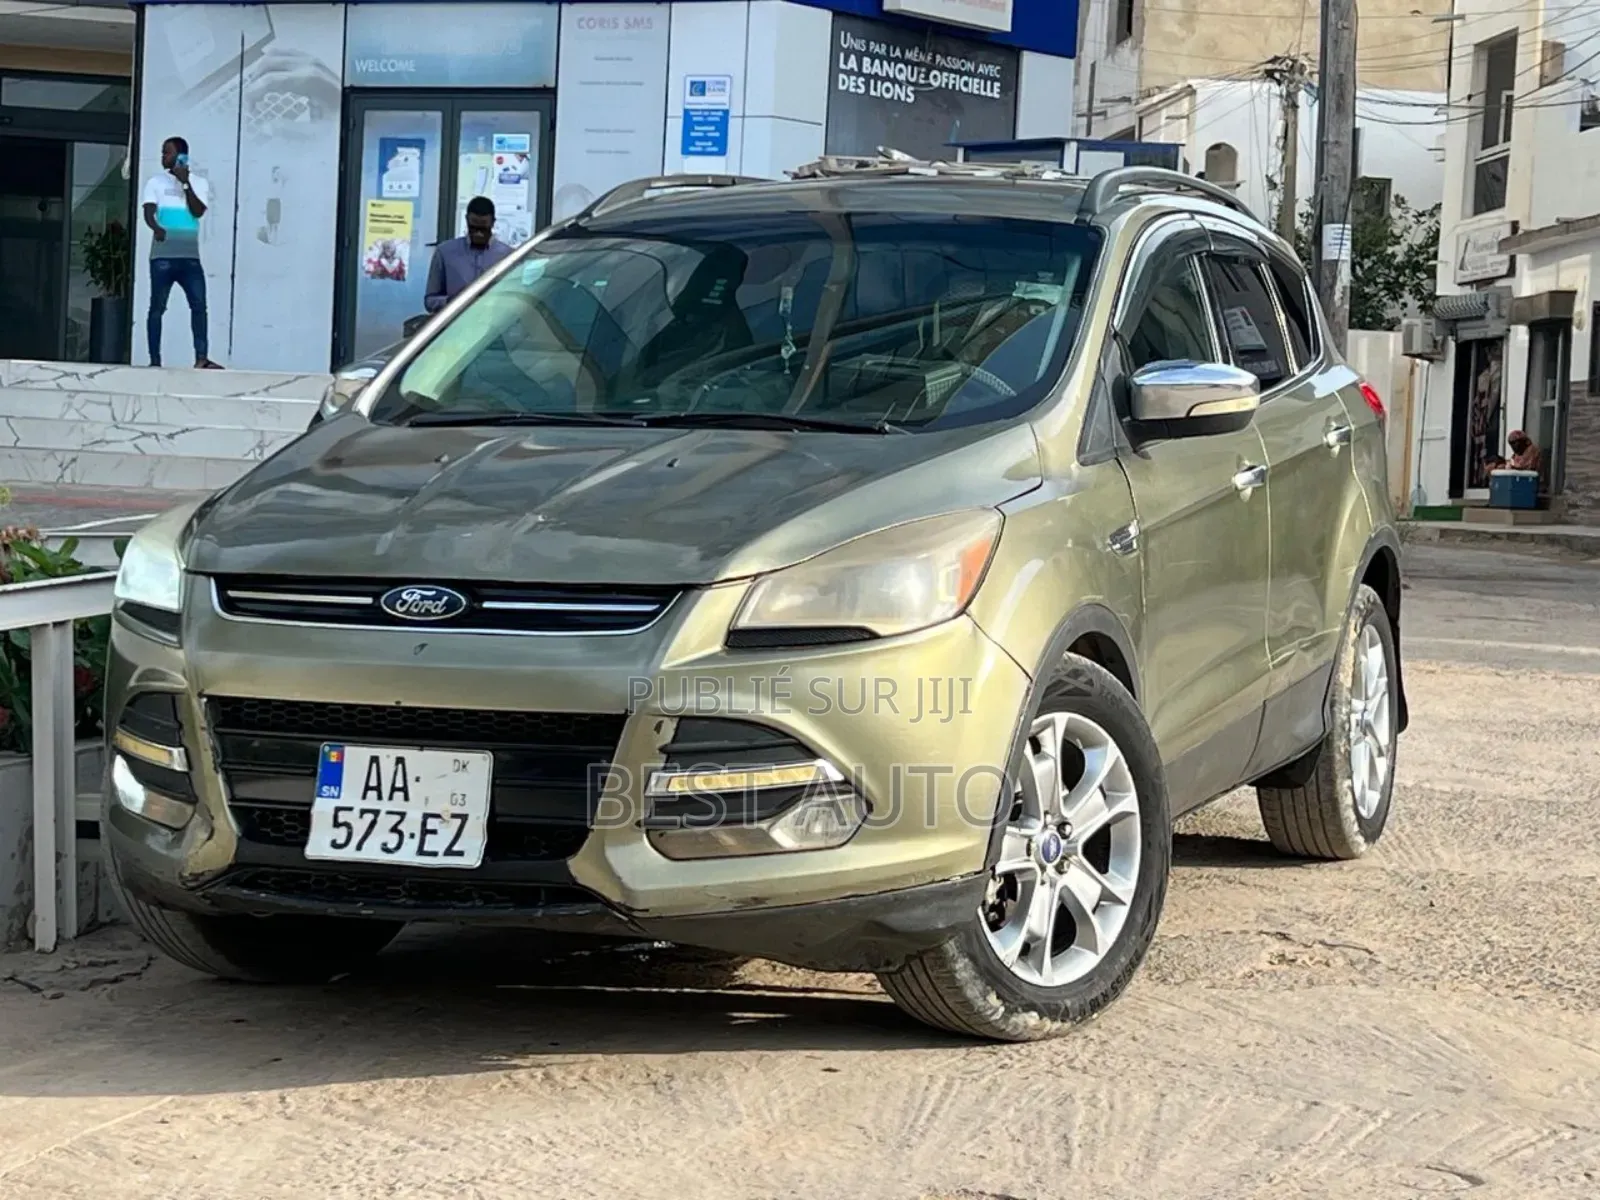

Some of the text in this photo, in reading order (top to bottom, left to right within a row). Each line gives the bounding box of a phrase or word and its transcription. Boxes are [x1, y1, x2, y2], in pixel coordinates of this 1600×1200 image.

[577, 16, 653, 30] CORIS SMS
[840, 31, 866, 51] UNIS
[869, 41, 886, 55] PAR
[889, 45, 902, 59] LA
[935, 53, 975, 73] PASSION
[976, 63, 1001, 79] AVEC
[354, 59, 416, 73] WELCOME
[839, 52, 1001, 99] LA BANQUE OFFICIELLE
[838, 73, 915, 103] DES LIONS
[396, 589, 449, 613] Ford
[452, 758, 471, 773] DK
[321, 786, 339, 797] SN
